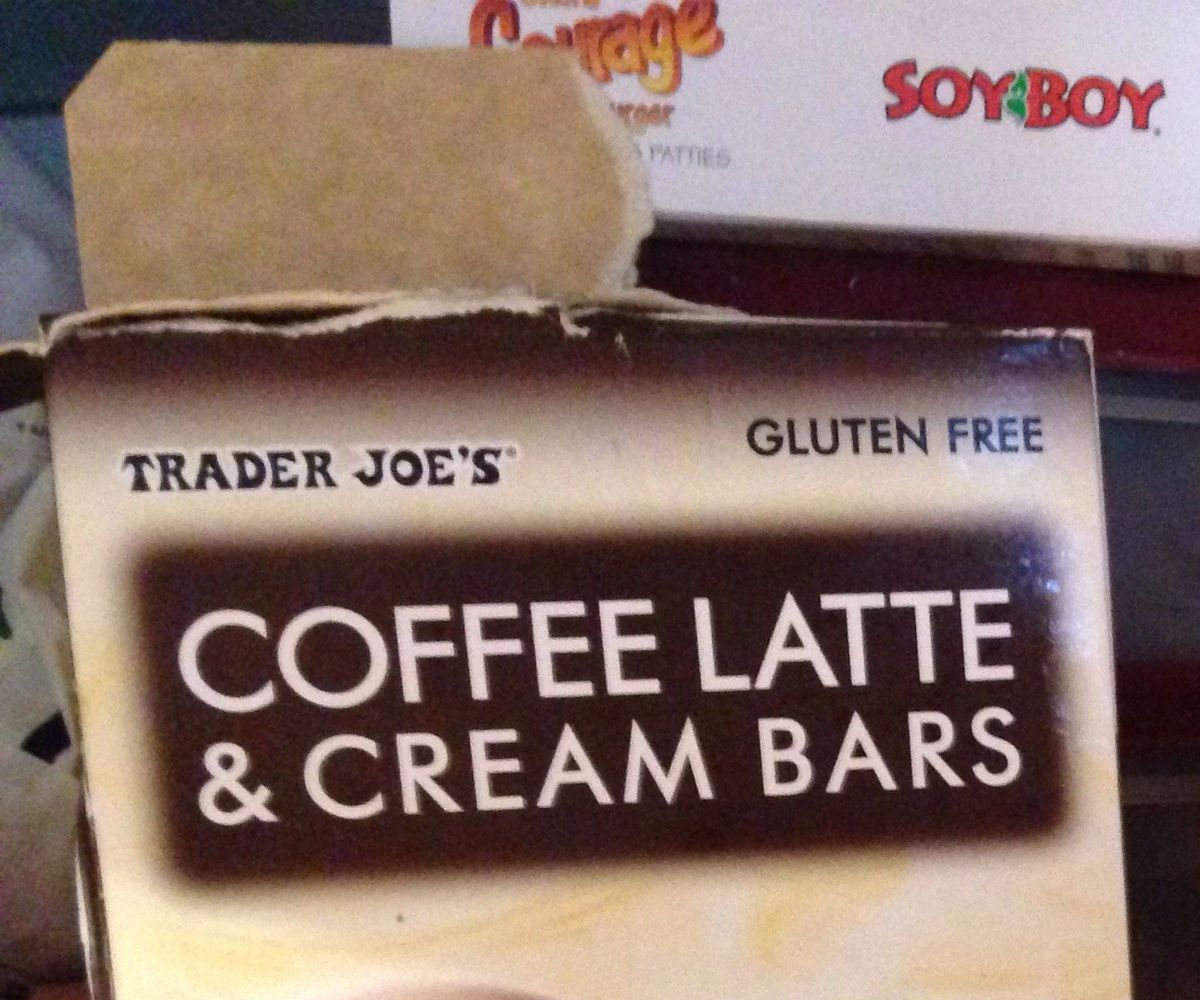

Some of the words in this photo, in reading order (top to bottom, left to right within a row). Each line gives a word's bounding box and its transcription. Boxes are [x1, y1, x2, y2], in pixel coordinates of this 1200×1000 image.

[609, 102, 676, 135] rger
[649, 143, 731, 169] PATTIES
[746, 415, 929, 457] GLUTEN
[947, 415, 1044, 455] FREE
[122, 450, 338, 492] TRADER
[352, 444, 505, 488] JOE'S
[177, 599, 662, 714] COFFEE
[692, 588, 1016, 693] LATTE
[198, 741, 281, 827] &
[303, 715, 715, 820] CREAM
[757, 705, 1023, 798] BARS
